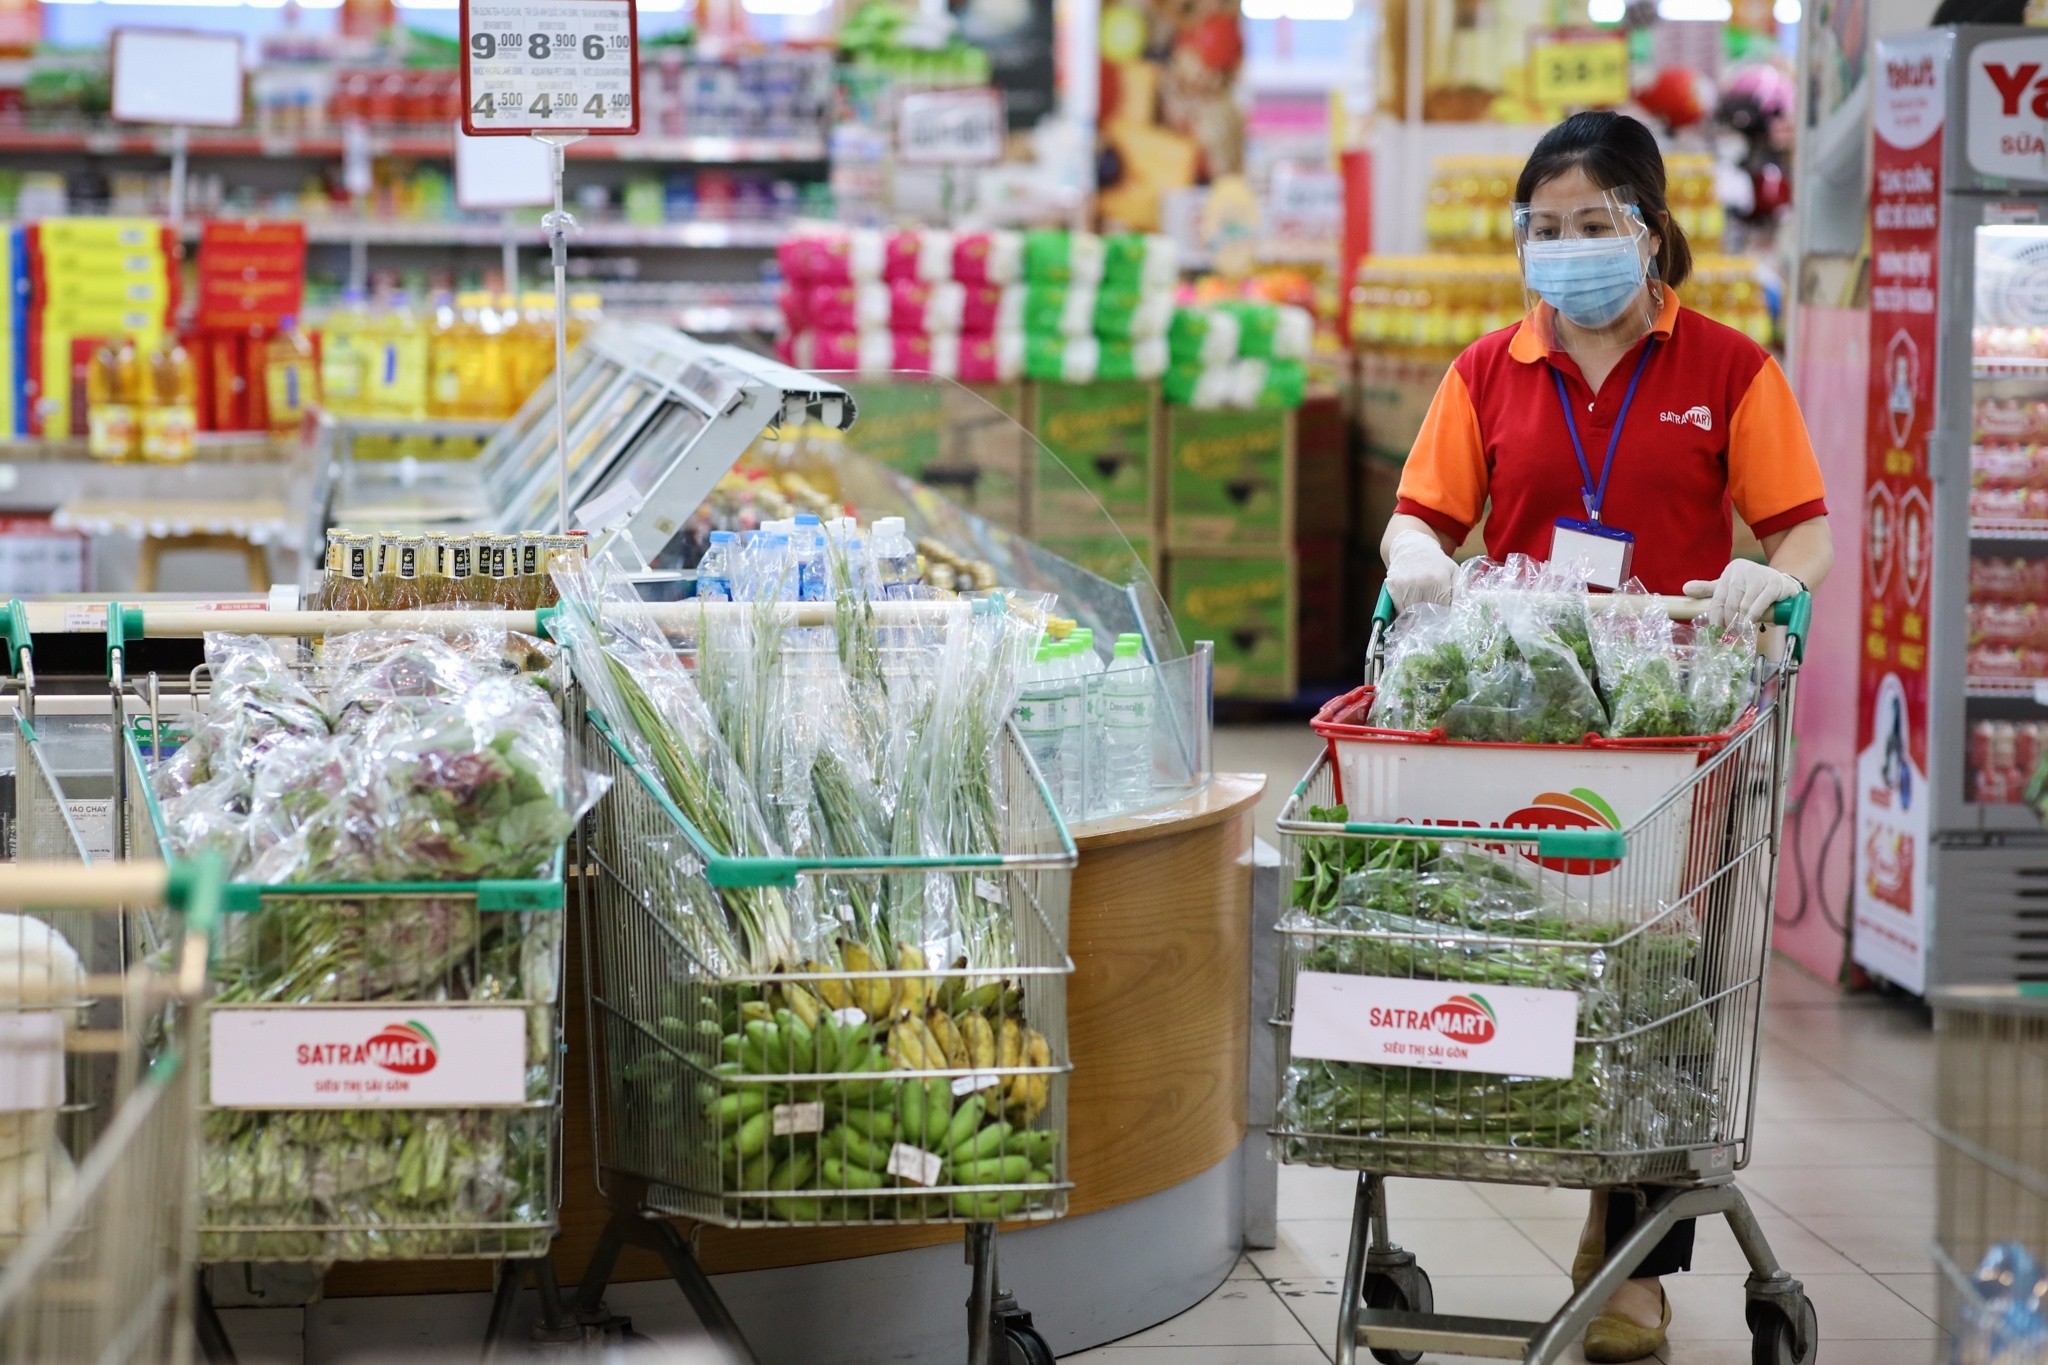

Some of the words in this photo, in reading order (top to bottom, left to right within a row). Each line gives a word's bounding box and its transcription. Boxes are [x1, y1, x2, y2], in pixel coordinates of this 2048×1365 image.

[1370, 1007, 1487, 1036] SATRAMART
[296, 1042, 428, 1066] SATRAMART
[1382, 1042, 1406, 1054] SIÊU
[1408, 1044, 1425, 1058] THỊ
[1428, 1044, 1444, 1058] SÀI
[1446, 1046, 1468, 1059] GÒN
